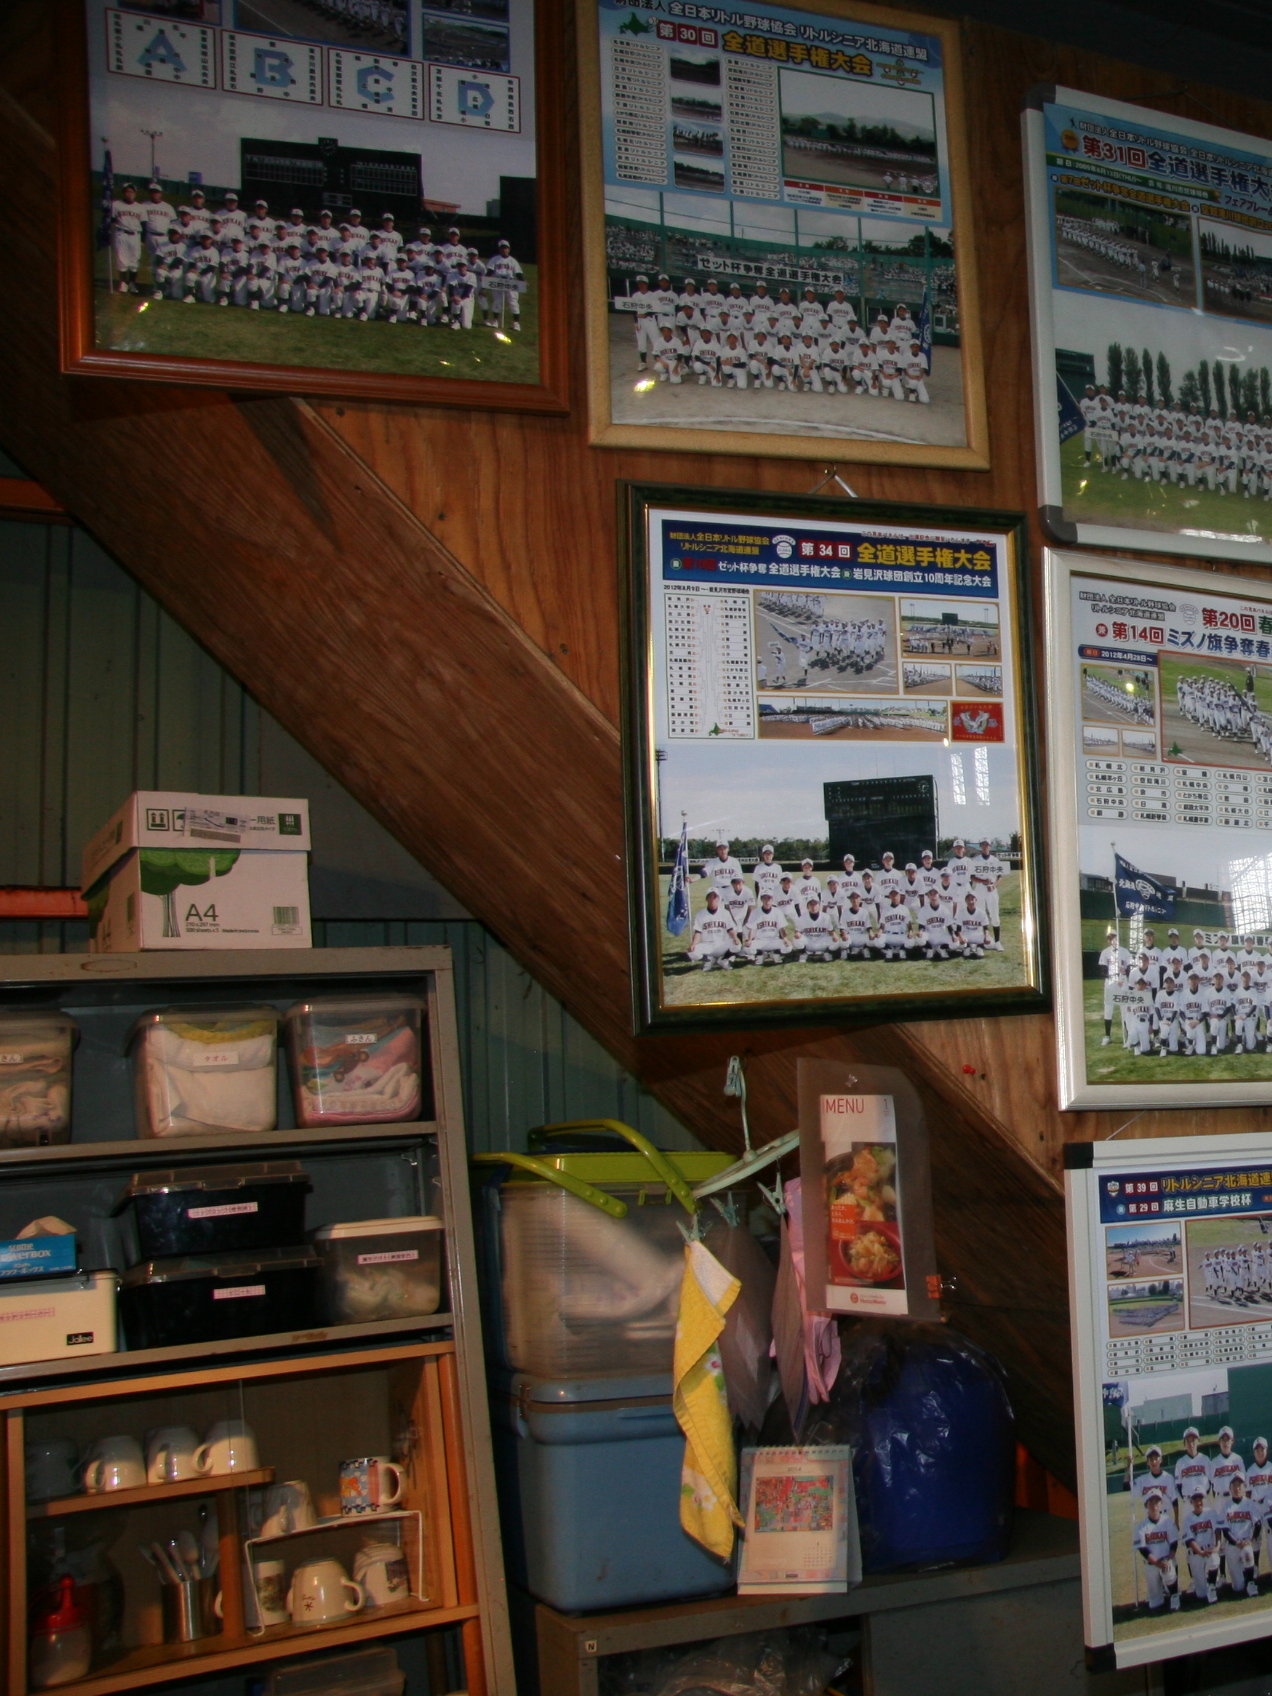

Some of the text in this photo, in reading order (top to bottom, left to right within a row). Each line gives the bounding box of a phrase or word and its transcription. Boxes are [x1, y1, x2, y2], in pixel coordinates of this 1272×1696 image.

[137, 32, 187, 72] A
[254, 48, 295, 88] B
[721, 30, 873, 77] 全道選手権大会
[357, 66, 396, 101] C
[458, 80, 495, 116] D
[800, 541, 851, 559] 第34回
[857, 542, 992, 571] 全道選手権大会
[185, 903, 219, 922] A4
[826, 1098, 865, 1114] MENU
[1163, 1193, 1252, 1212] 麻生自動車学校杯
